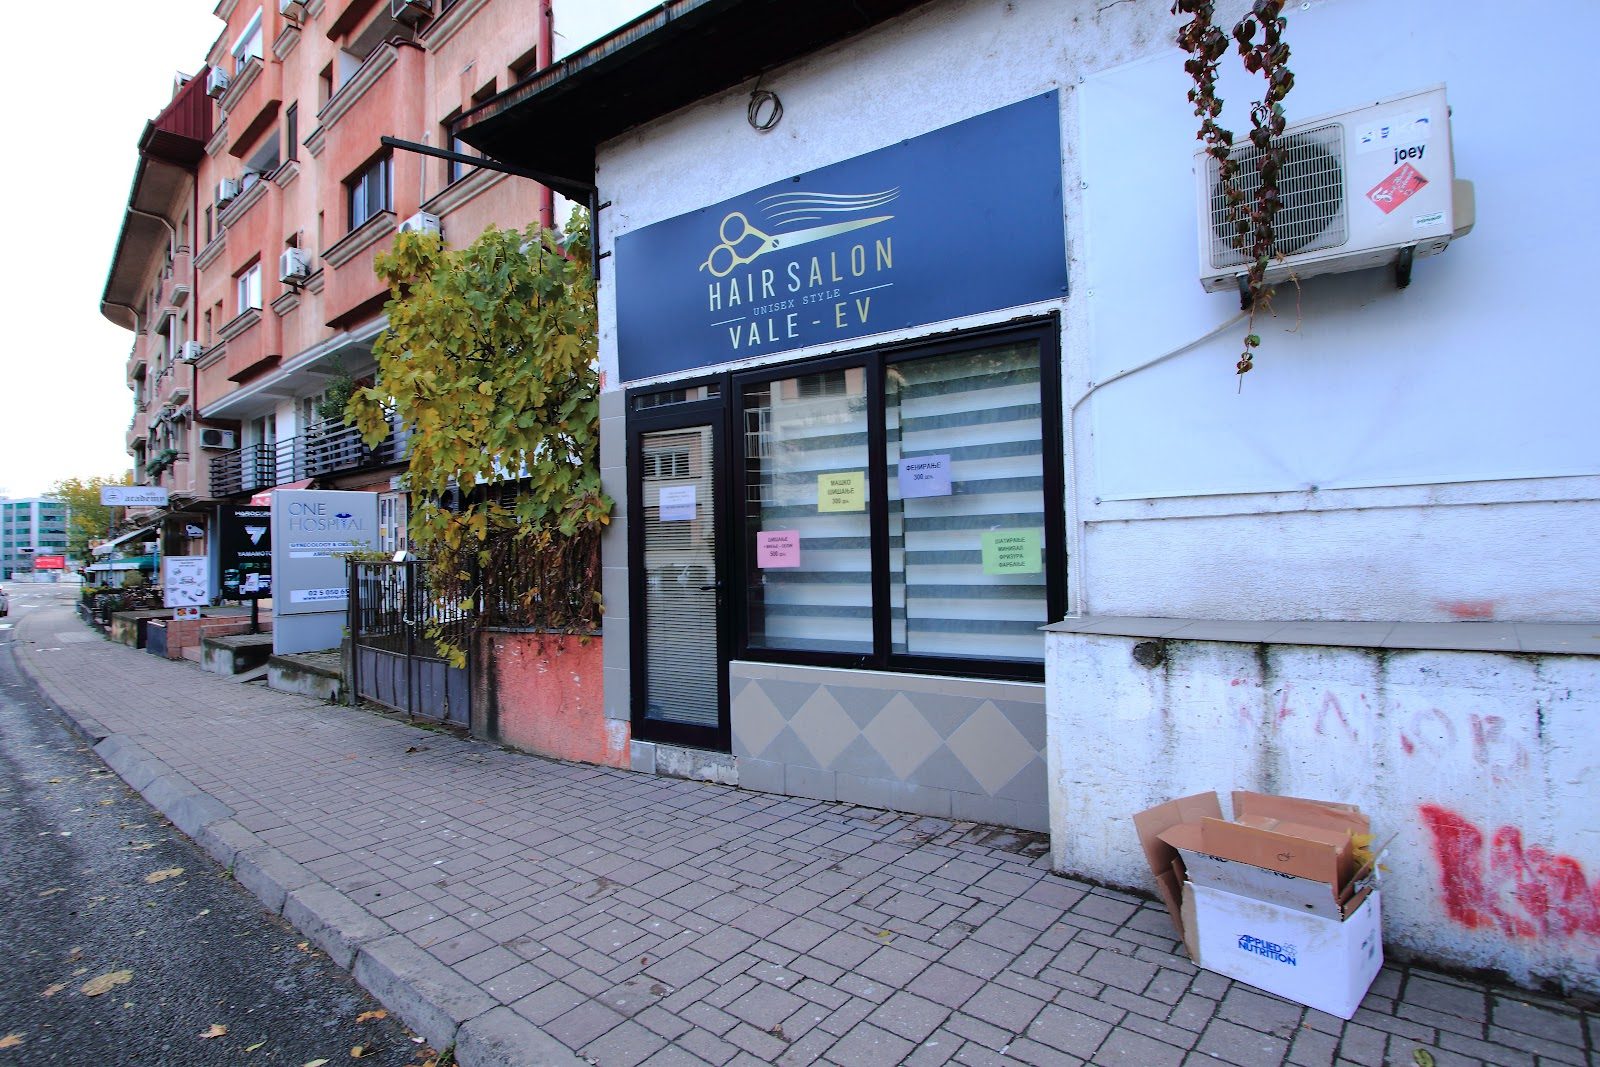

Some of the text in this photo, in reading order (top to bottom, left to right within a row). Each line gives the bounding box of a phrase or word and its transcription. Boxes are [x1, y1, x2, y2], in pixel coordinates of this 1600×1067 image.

[1394, 145, 1425, 165] joey
[753, 289, 841, 316] UNISEX STYLE
[729, 312, 800, 350] VALE
[835, 296, 871, 329] EV
[906, 462, 941, 471] ФЕНИРАЊЕ
[288, 502, 327, 516] ONE
[1236, 934, 1282, 953] APPLIED
[1238, 940, 1297, 967] NUTRITION
